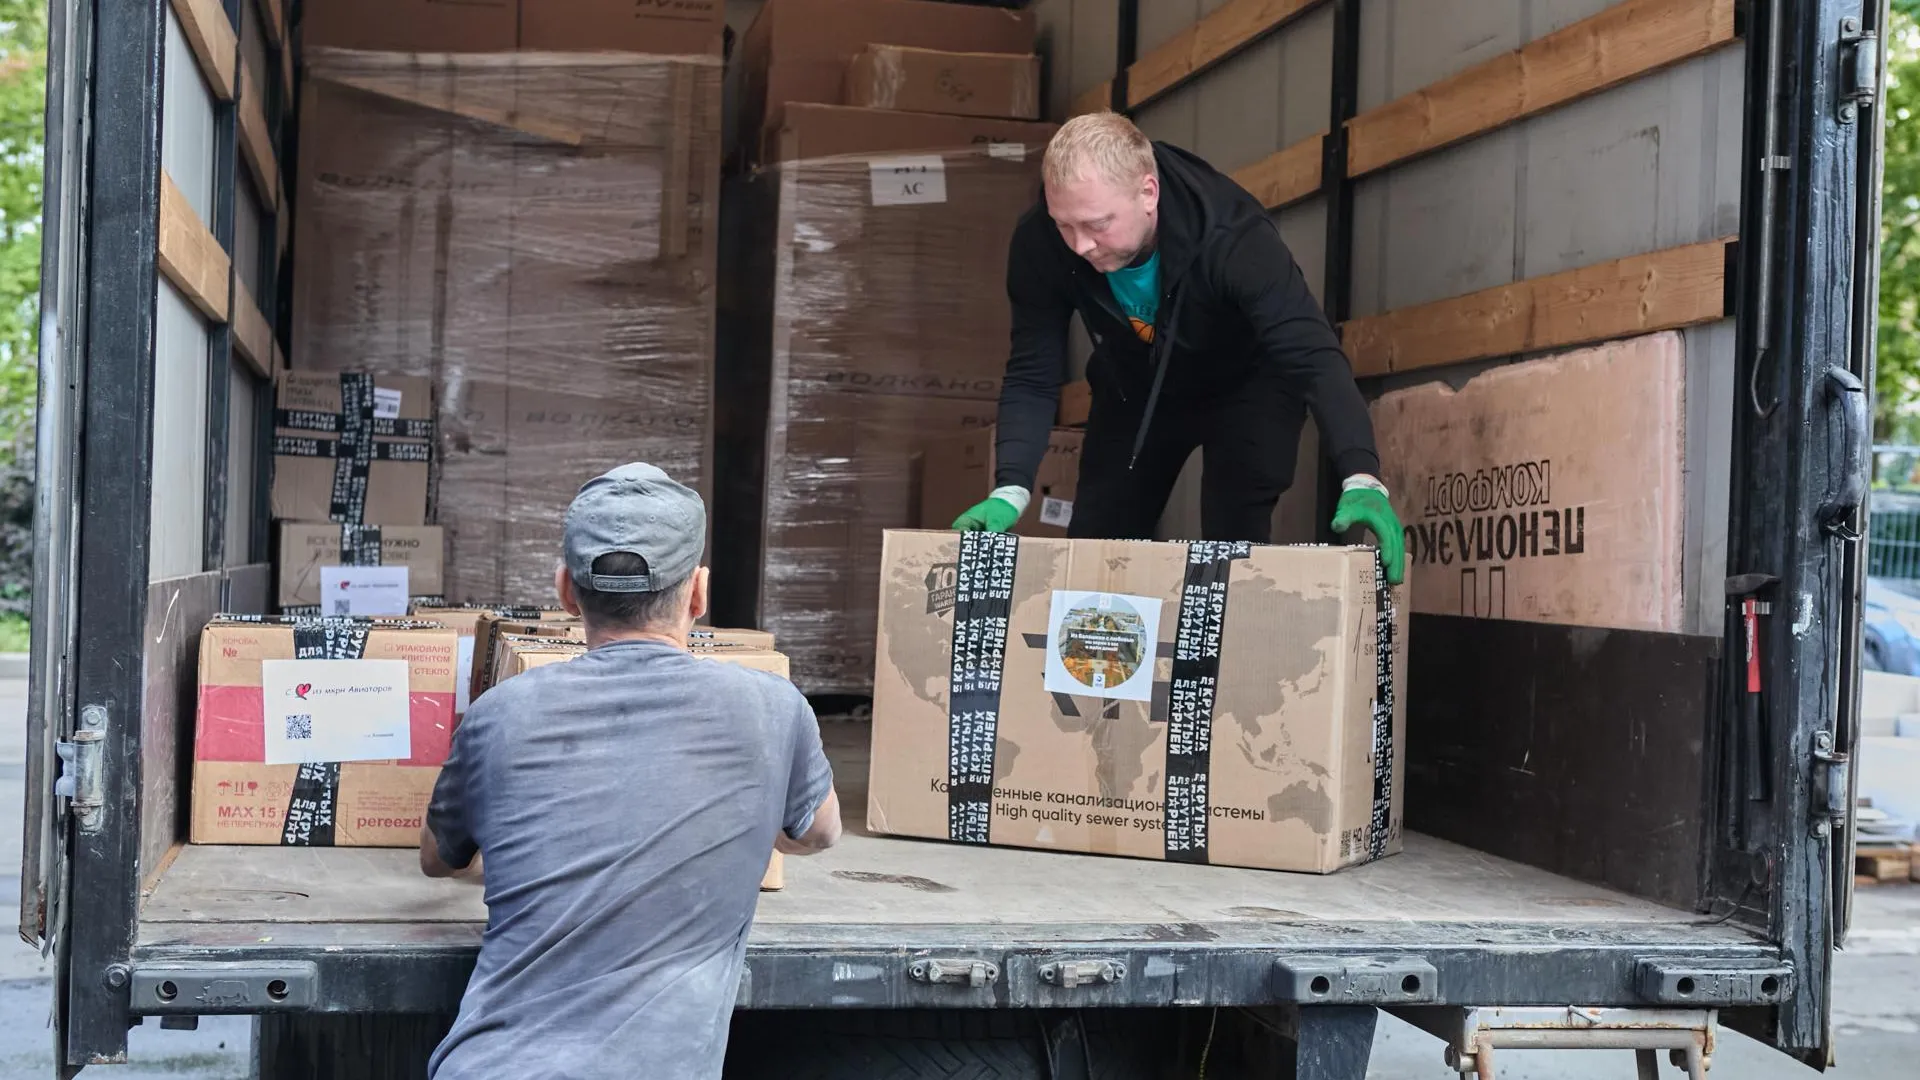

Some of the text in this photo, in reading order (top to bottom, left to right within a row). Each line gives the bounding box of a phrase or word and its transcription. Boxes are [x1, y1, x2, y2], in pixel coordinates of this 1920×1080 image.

[1424, 459, 1550, 517] КОМФОРТ
[396, 644, 451, 653] УПАКОВАНО
[953, 620, 966, 682] КРУТЫХ
[965, 618, 980, 679] КРУТЫХ
[979, 616, 996, 678] КРУТЫХ
[1188, 597, 1206, 661] КРУТЫХ
[1206, 594, 1224, 658] КРУТЫХ
[402, 655, 451, 663] КЛИЕНТОМ
[414, 667, 450, 676] СТЕКЛО
[971, 710, 984, 772] КРУТЫХ
[1181, 691, 1195, 755] КРУТЫХ
[1199, 688, 1213, 752] КРУТЫХ
[231, 820, 284, 829] ПЕРЕГРУЖА
[260, 806, 277, 818] 15
[356, 816, 422, 830] pereezd
[995, 803, 1165, 832] High quality sewer syste
[1047, 792, 1165, 812] канализацион
[1178, 788, 1190, 851] КРУТЫХ
[1194, 785, 1206, 848] КРУТЫХ
